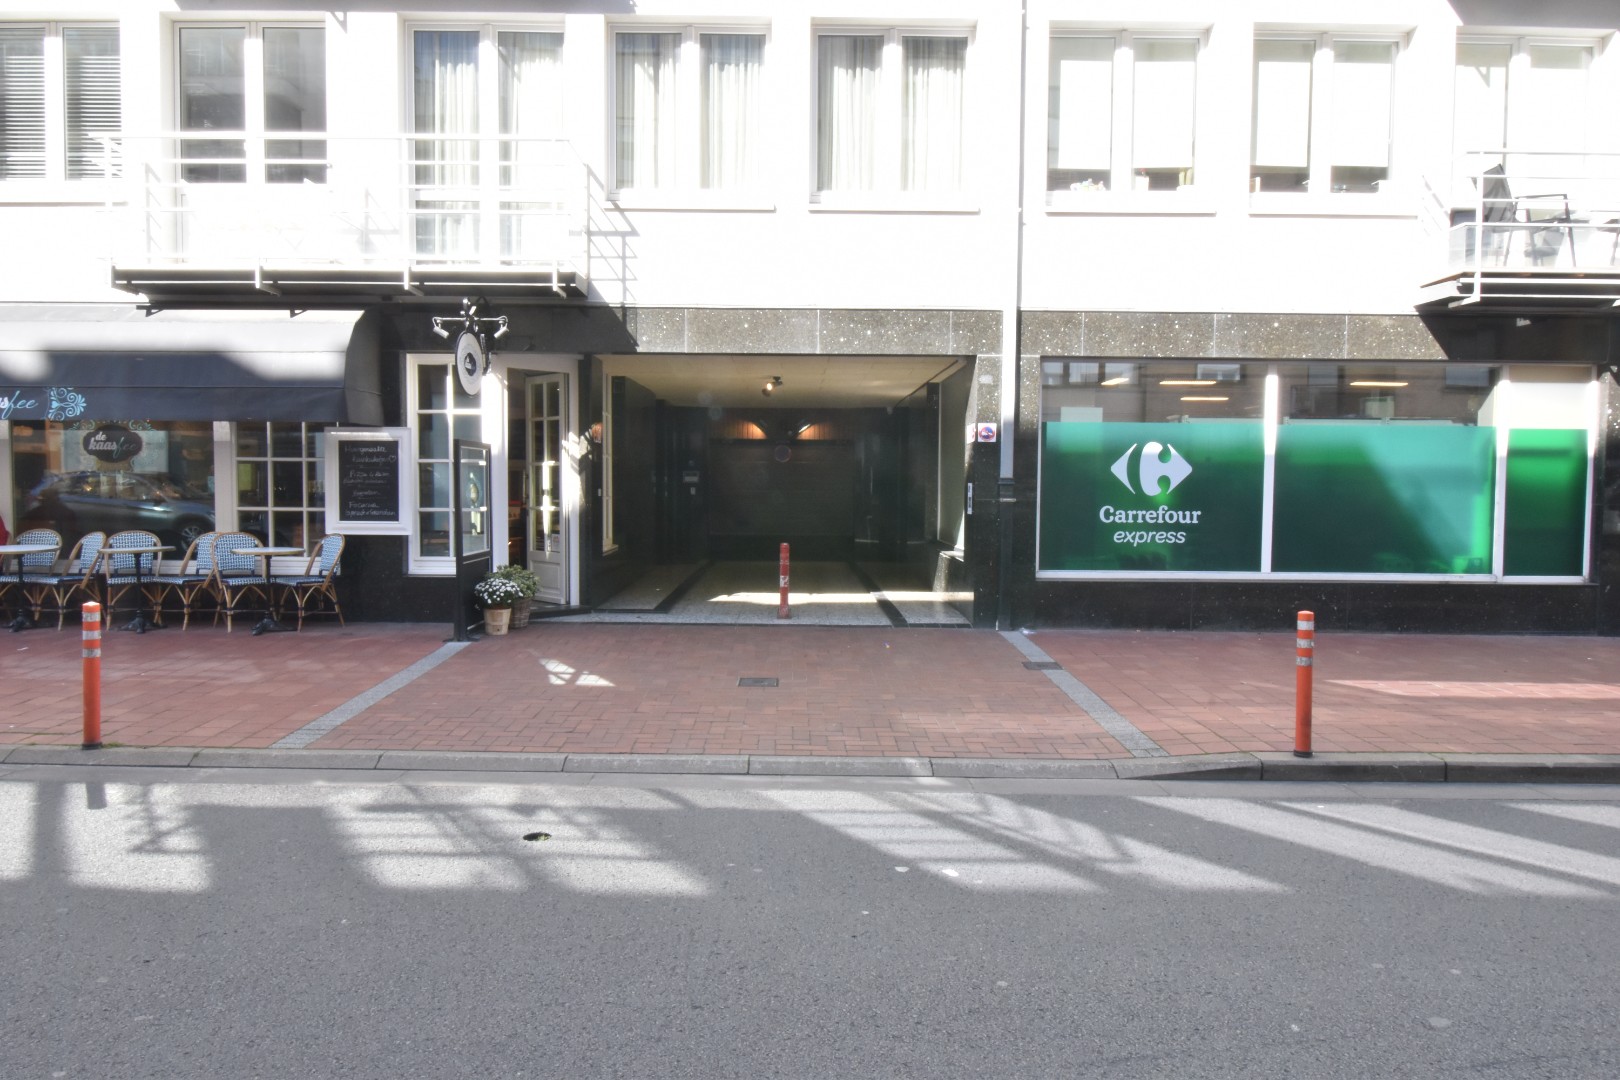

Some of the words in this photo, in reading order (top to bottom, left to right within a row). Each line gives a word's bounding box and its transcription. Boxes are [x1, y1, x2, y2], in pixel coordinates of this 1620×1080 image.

[0, 390, 38, 420] sfee
[95, 431, 107, 441] de
[1099, 505, 1202, 524] Carrefour
[1113, 530, 1187, 547] express
